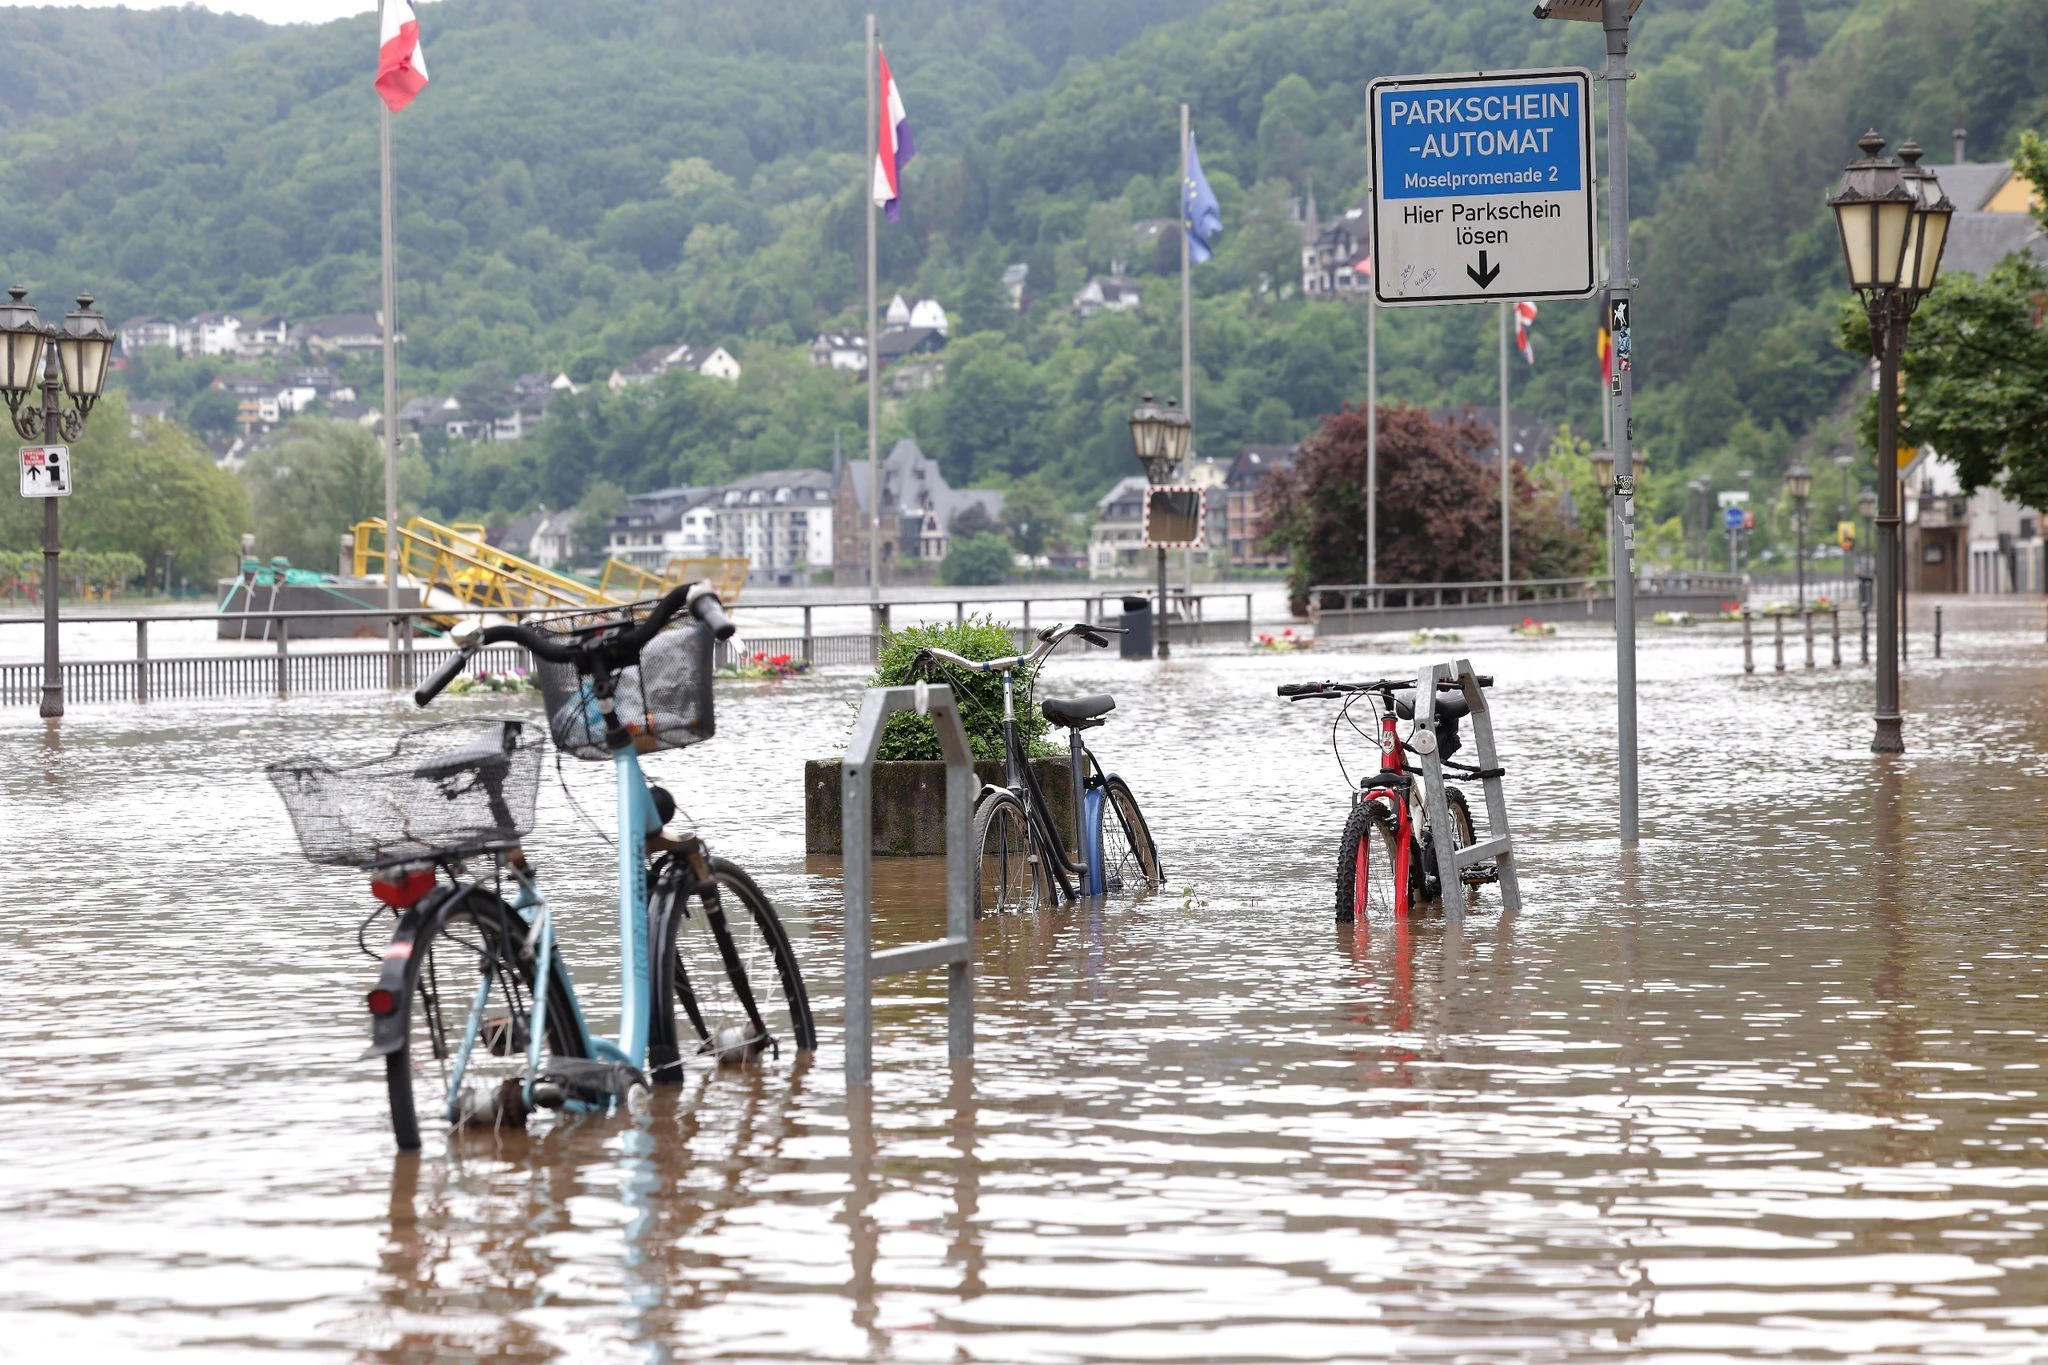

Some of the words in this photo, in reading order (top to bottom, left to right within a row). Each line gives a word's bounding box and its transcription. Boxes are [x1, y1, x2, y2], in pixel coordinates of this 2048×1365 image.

[1390, 92, 1569, 126] PARKSCHEIN
[1409, 128, 1553, 158] -AUTOMAT
[1404, 169, 1542, 190] Moselpromenade
[1548, 166, 1559, 182] 2
[1404, 206, 1444, 224] Hier
[1452, 200, 1561, 222] Parkschein
[1456, 227, 1508, 245] lösen
